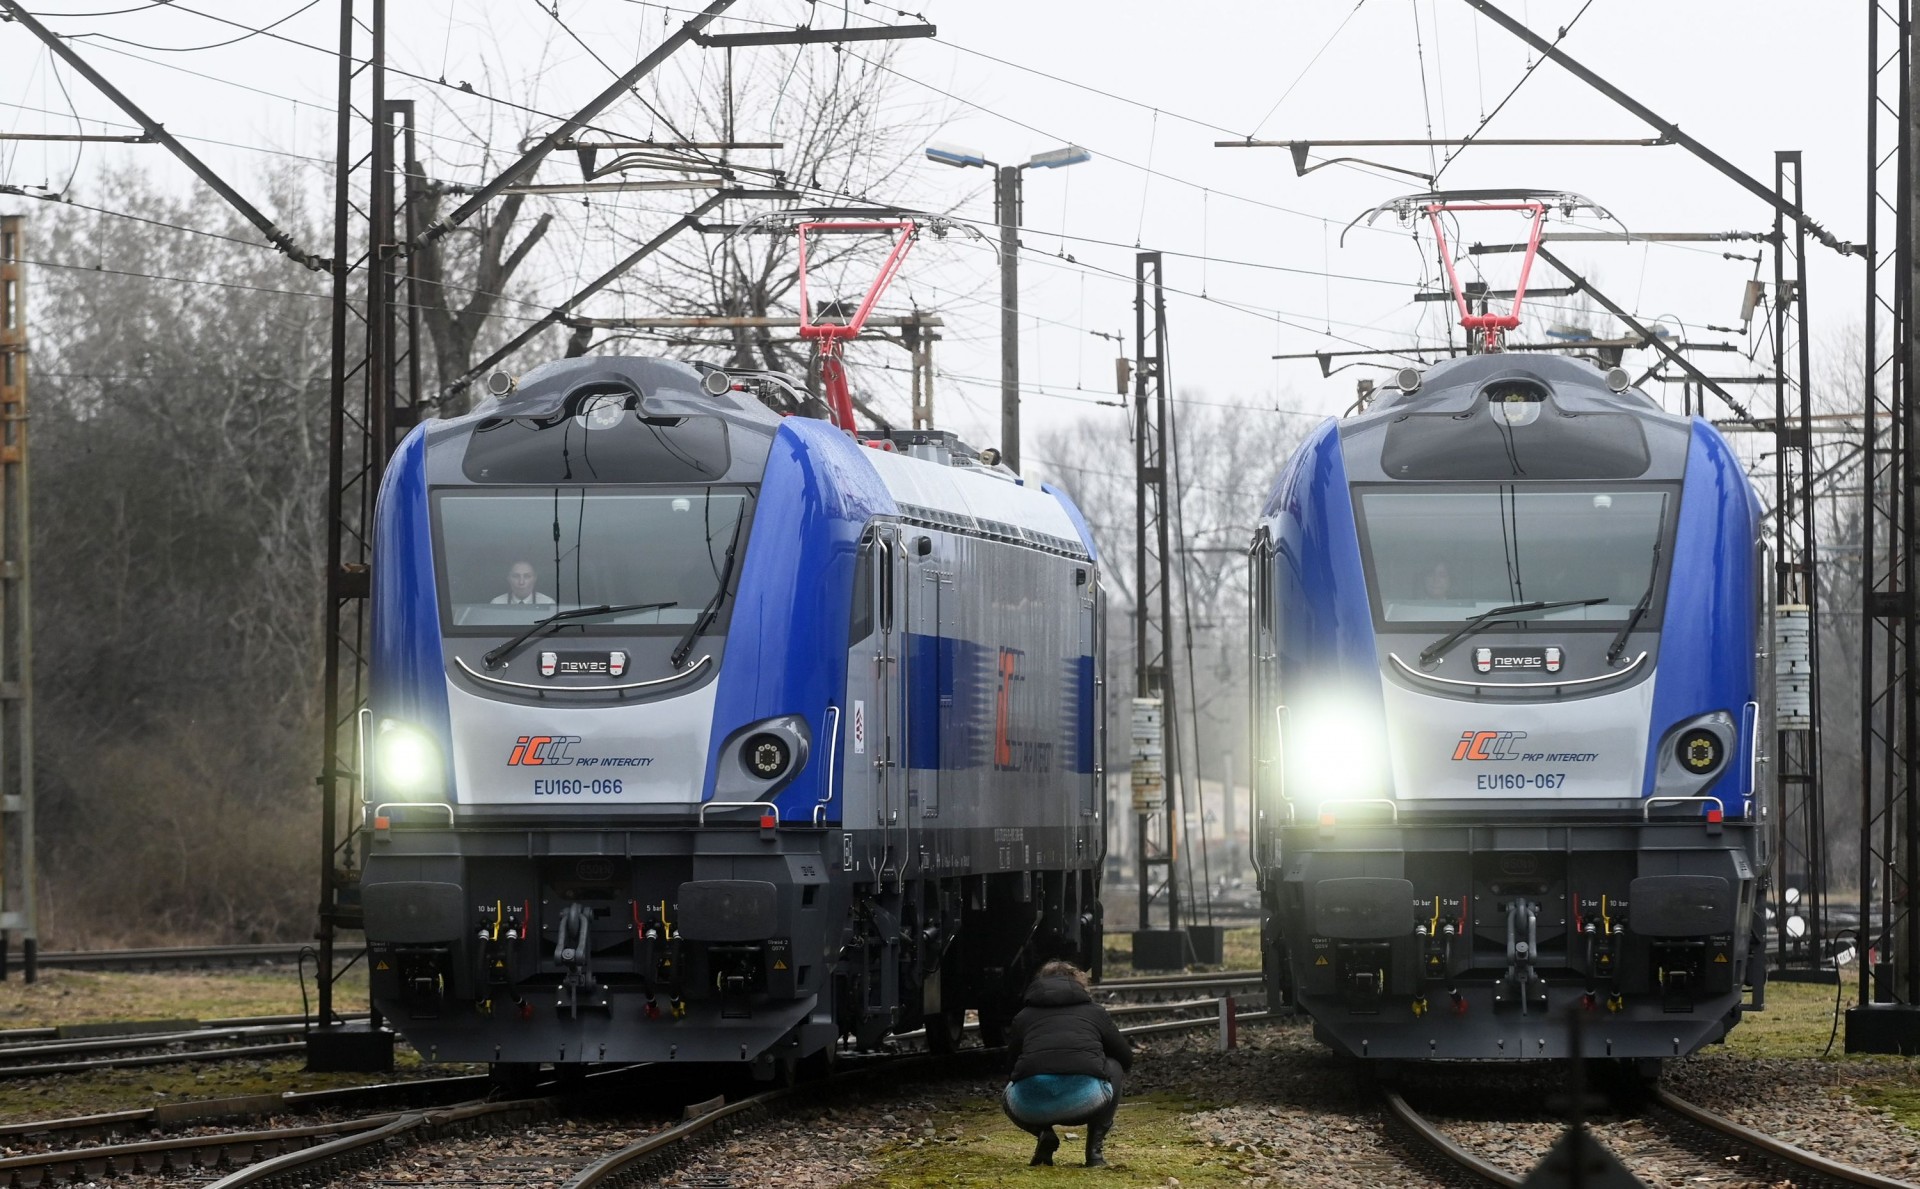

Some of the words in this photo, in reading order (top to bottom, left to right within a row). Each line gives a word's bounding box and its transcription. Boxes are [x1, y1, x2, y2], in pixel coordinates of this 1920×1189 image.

[1521, 753, 1544, 762] PKP
[1545, 753, 1599, 762] INTERCITY
[575, 757, 599, 767] PKP
[600, 757, 654, 767] INTERCITY
[1477, 773, 1566, 790] EU160-067
[534, 779, 623, 795] EU160-066
[1443, 898, 1448, 906] 5
[1449, 898, 1459, 906] bar
[1581, 899, 1587, 907] 5
[1588, 899, 1598, 907] bar
[1609, 899, 1617, 907] 10
[478, 905, 485, 913] 10
[486, 905, 497, 913] bar
[506, 905, 511, 913] 5
[513, 905, 523, 913] bar
[646, 904, 651, 912] 5
[652, 904, 662, 912] bar
